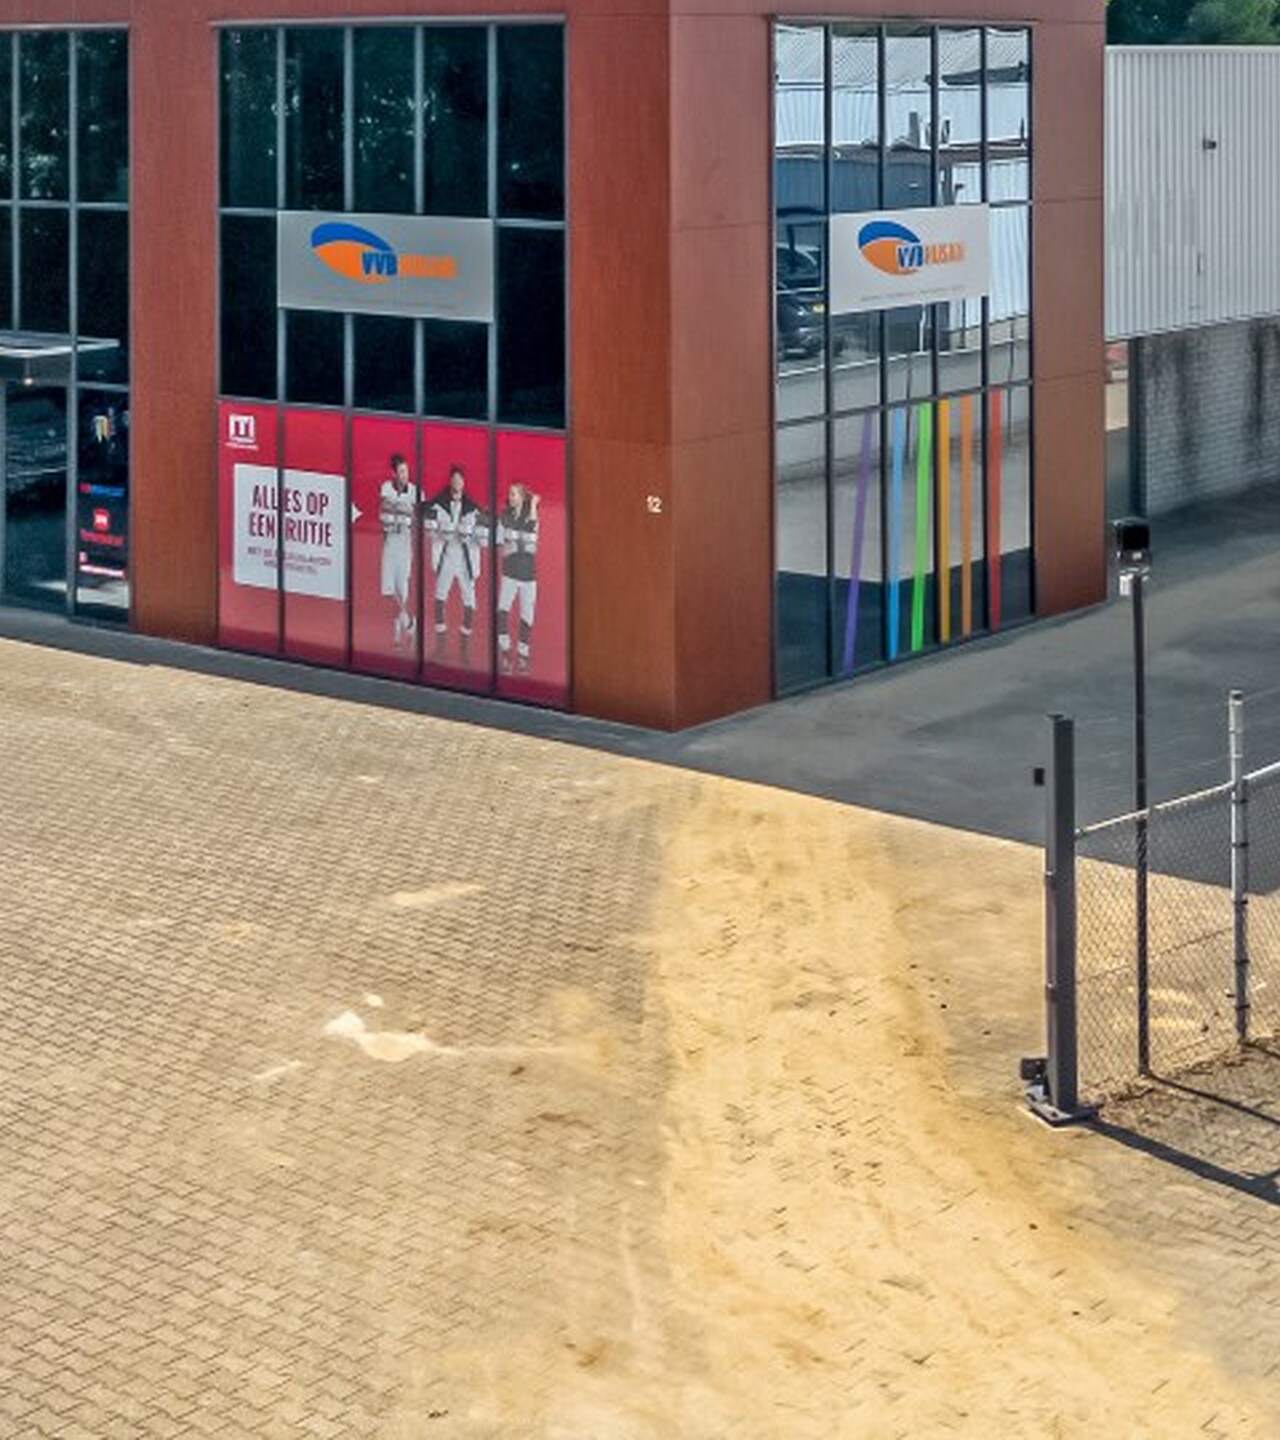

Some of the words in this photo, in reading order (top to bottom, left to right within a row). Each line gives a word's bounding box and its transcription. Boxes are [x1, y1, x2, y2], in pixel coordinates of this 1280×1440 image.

[252, 485, 302, 513] ALLES
[306, 492, 329, 517] OP
[249, 513, 276, 539] EEN
[285, 519, 333, 548] RIJTJE
